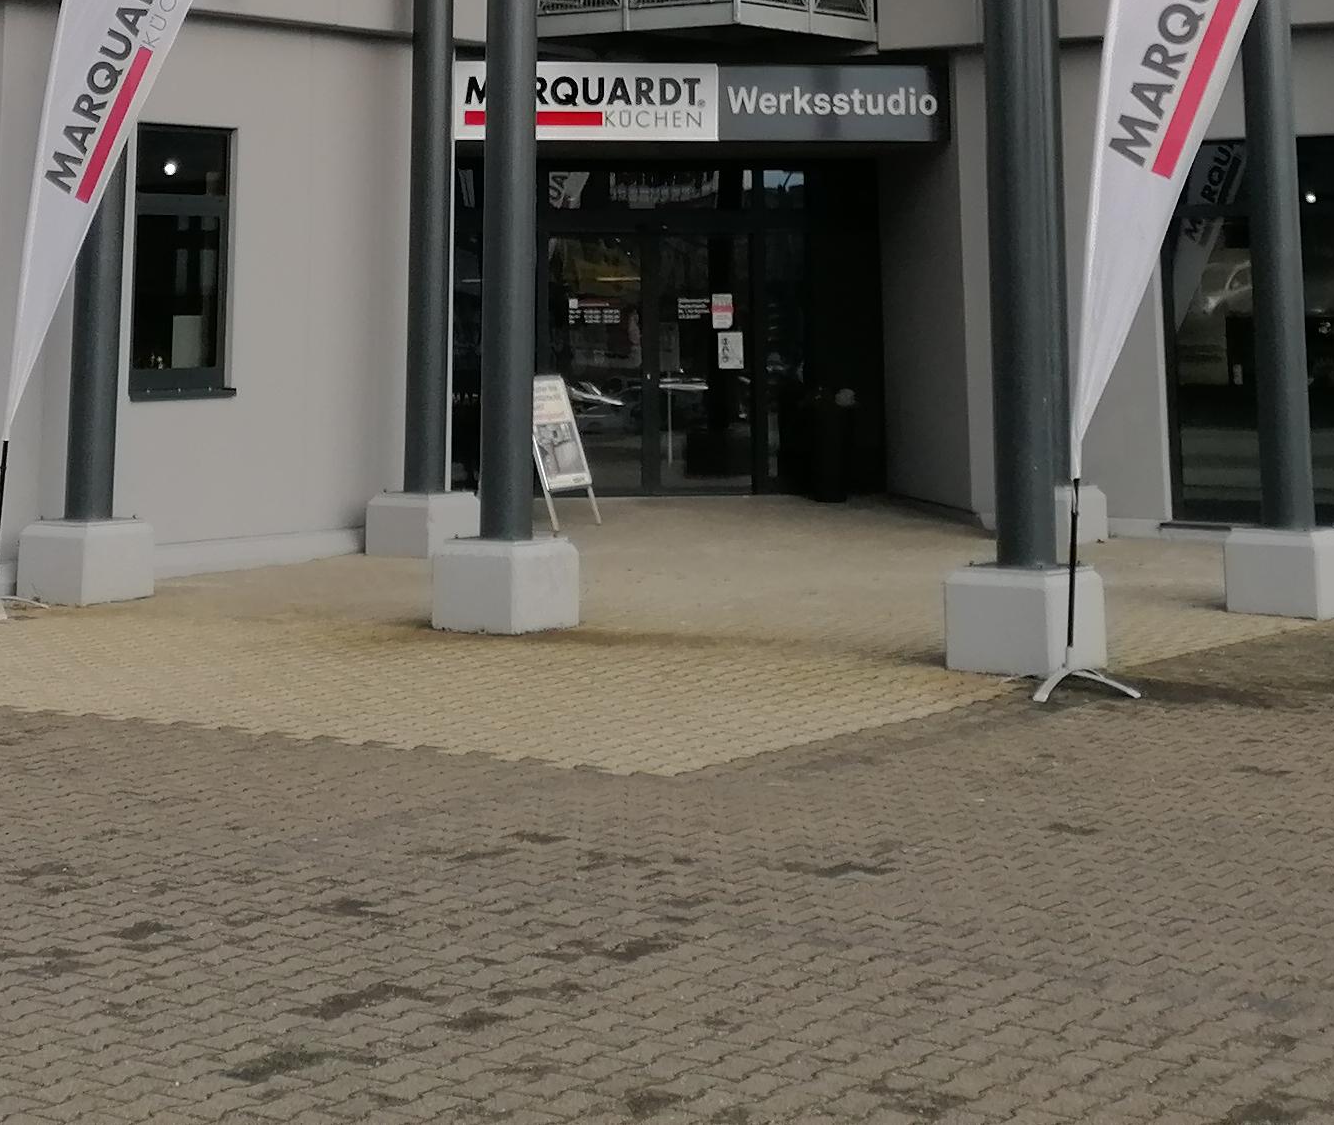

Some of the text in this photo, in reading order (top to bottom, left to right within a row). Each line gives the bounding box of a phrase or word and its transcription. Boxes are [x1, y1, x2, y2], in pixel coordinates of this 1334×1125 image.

[464, 76, 703, 107] MRQUARDT
[727, 85, 938, 117] Werksstudio
[603, 109, 703, 130] KÜCHEN
